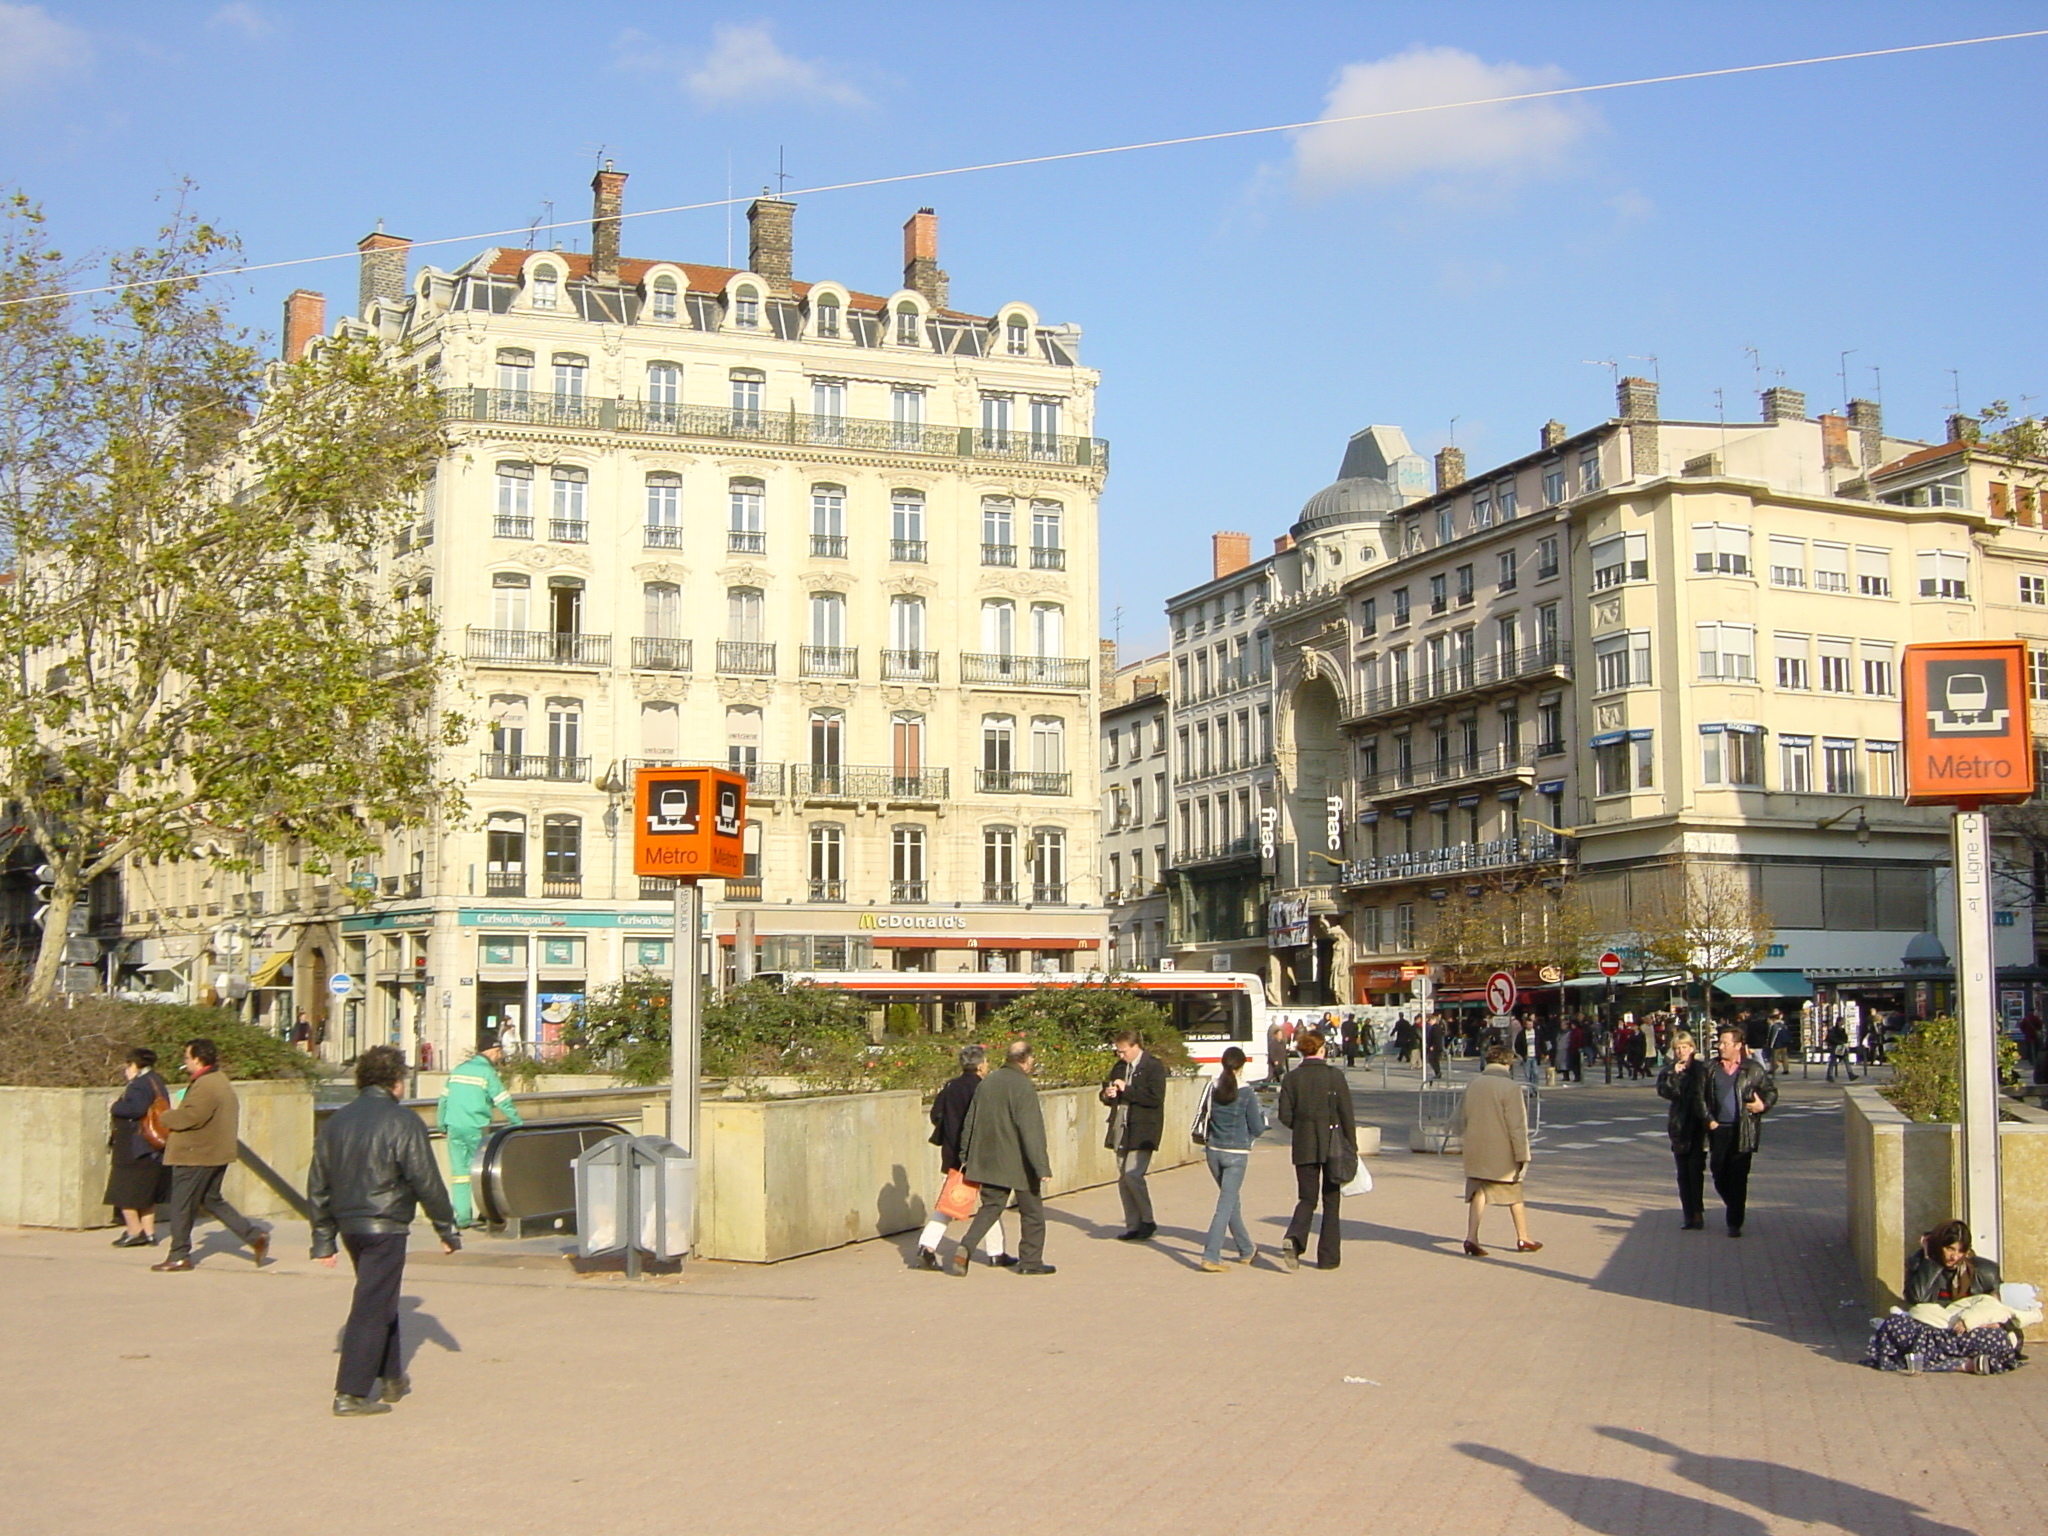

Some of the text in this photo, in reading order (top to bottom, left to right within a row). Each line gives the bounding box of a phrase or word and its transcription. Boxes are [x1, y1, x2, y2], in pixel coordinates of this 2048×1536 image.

[1928, 754, 2012, 779] Métro
[1261, 806, 1277, 859] fnac
[1327, 795, 1343, 851] fnac
[645, 846, 699, 865] Métro
[713, 846, 738, 868] Métro
[1965, 842, 1984, 885] Ligne
[859, 913, 967, 930] McDonald's
